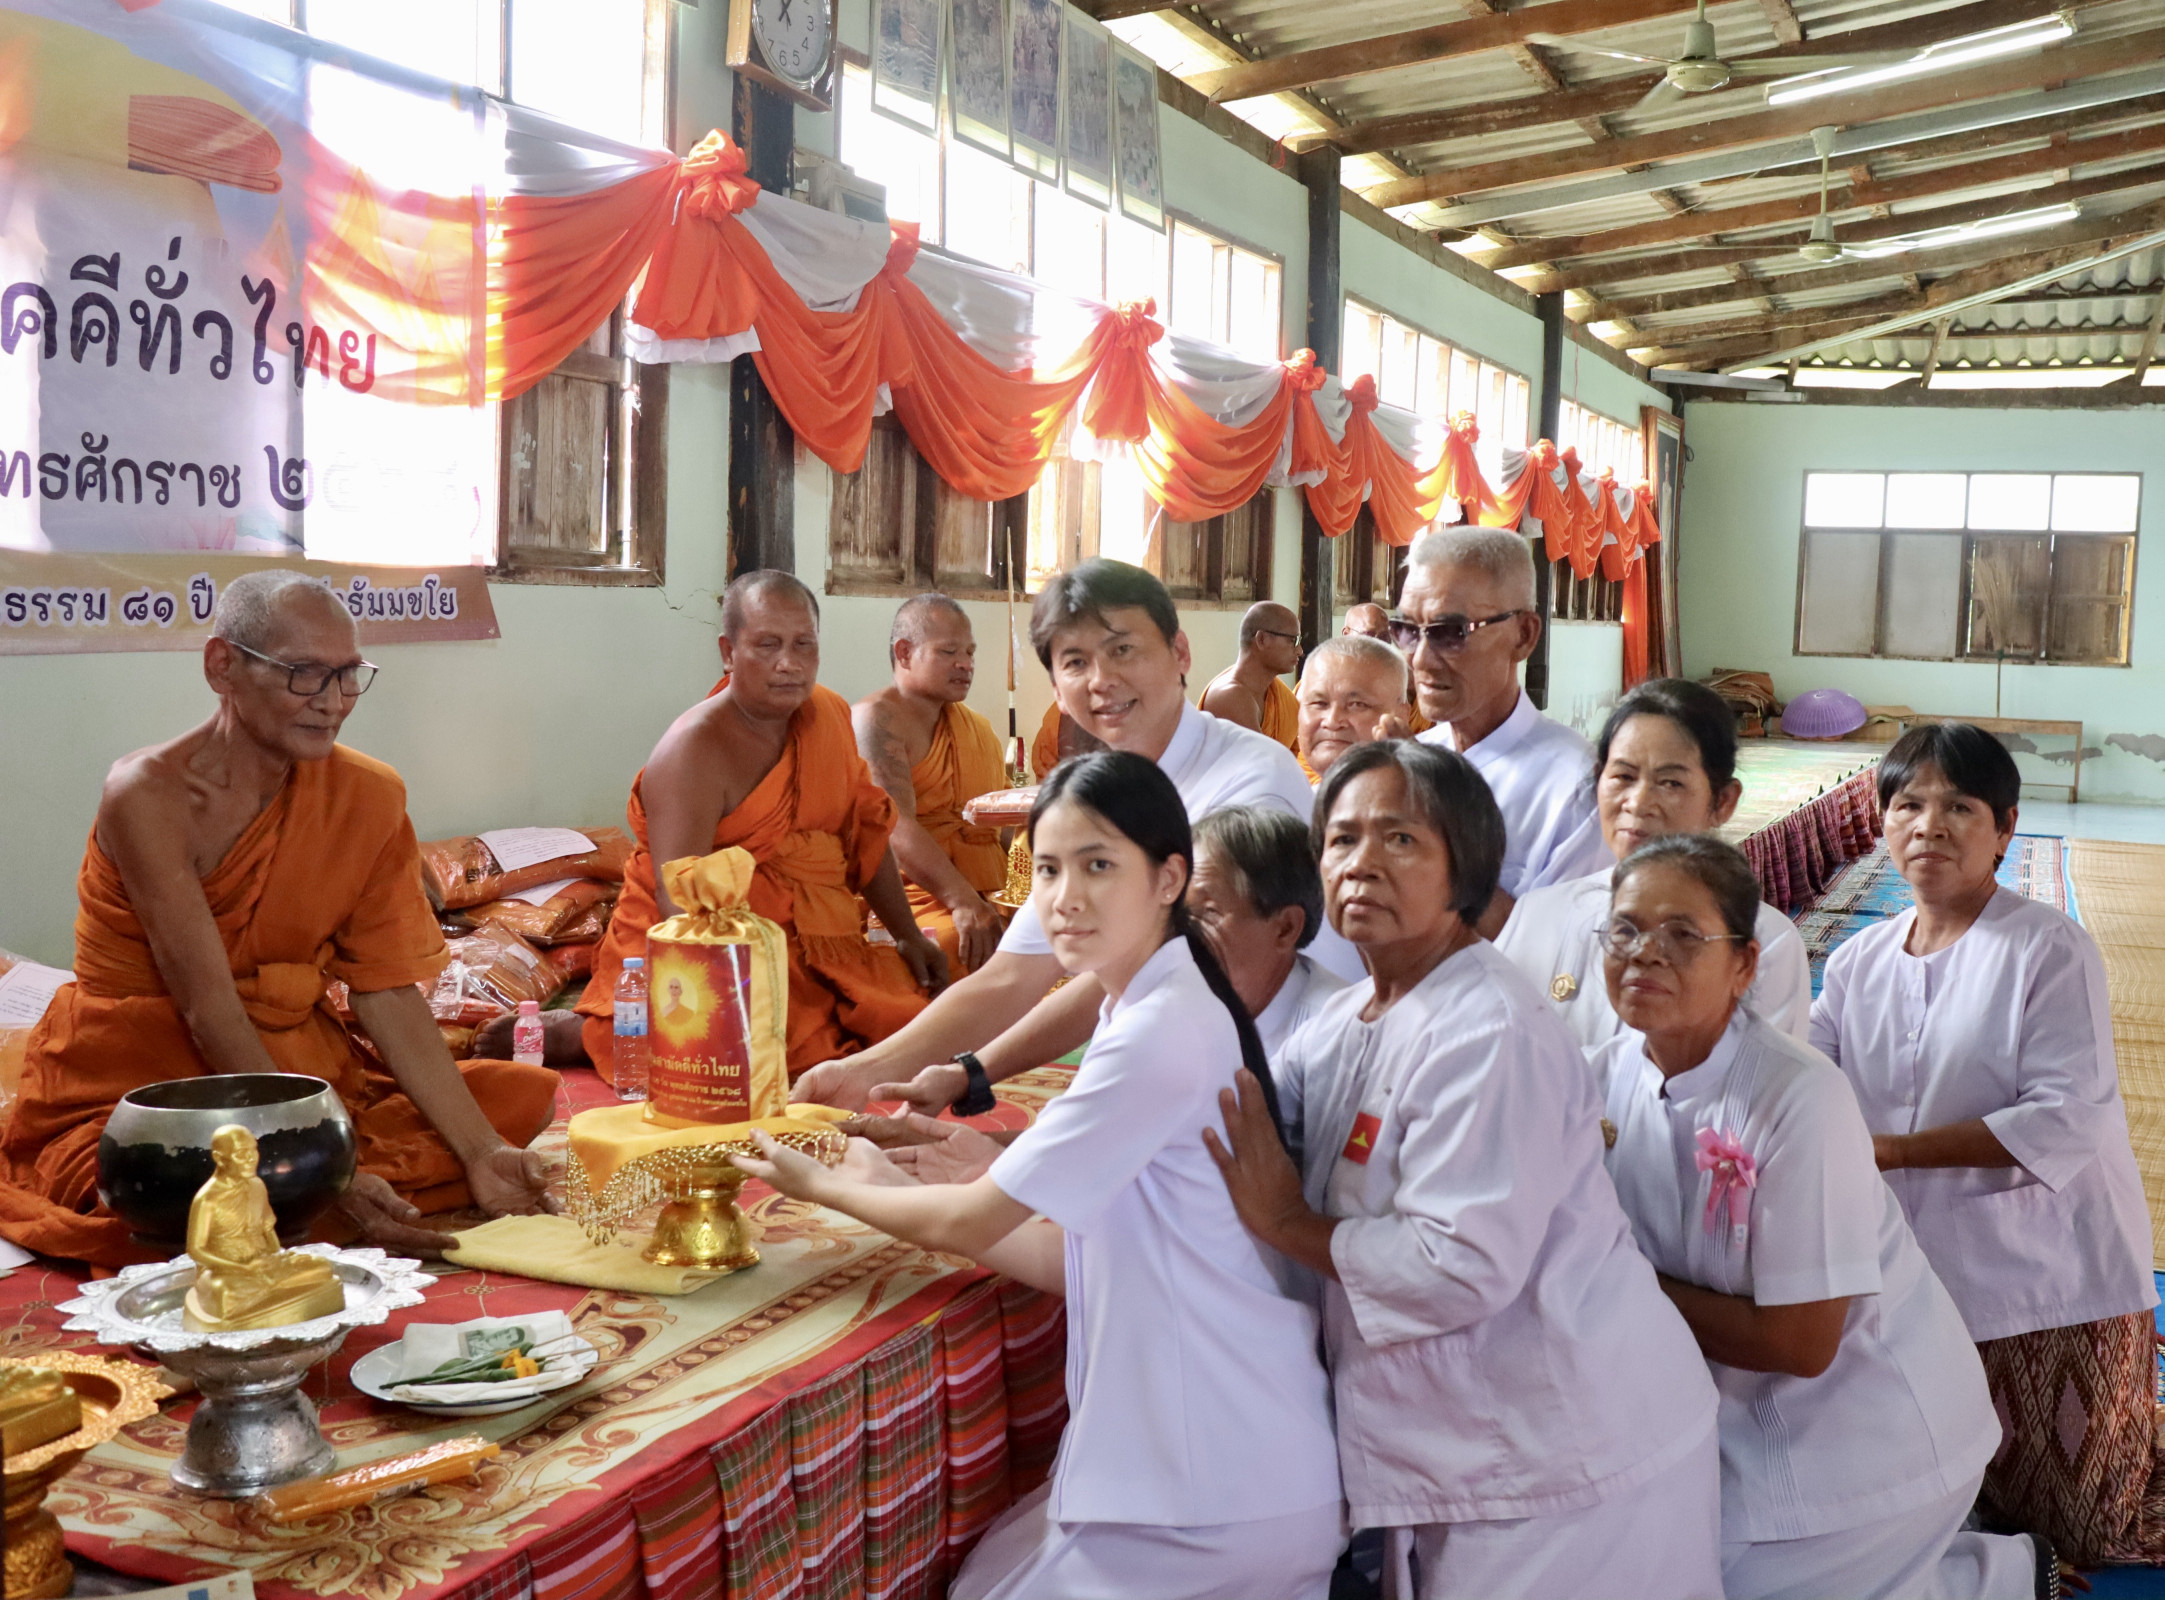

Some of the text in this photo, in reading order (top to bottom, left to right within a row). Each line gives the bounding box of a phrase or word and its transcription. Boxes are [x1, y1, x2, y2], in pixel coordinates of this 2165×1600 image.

[1, 236, 376, 393] คคีทั่วไทย
[123, 591, 174, 623] ๘๑
[191, 577, 213, 620] ปี
[338, 578, 456, 617] ธัมมชโย
